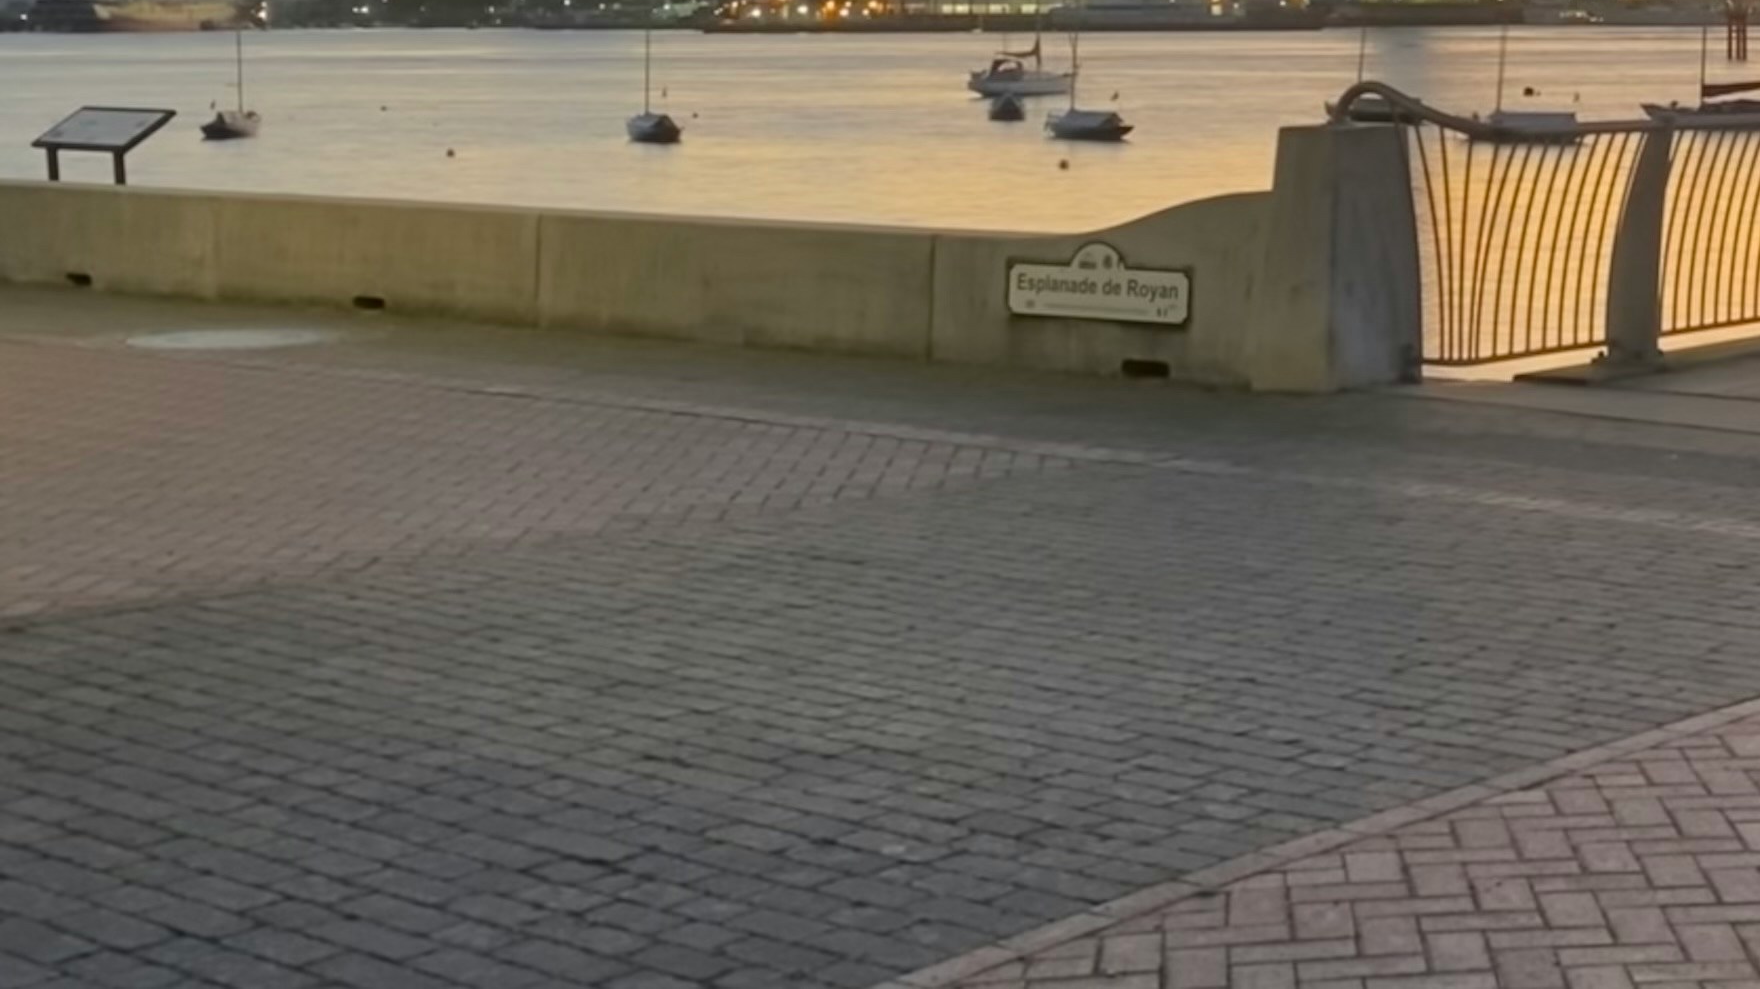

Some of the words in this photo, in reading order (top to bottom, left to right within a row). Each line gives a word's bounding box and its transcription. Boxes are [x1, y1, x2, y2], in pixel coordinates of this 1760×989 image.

[1016, 273, 1097, 296] Esplanade
[1102, 278, 1122, 296] de
[1127, 279, 1179, 303] Royan
